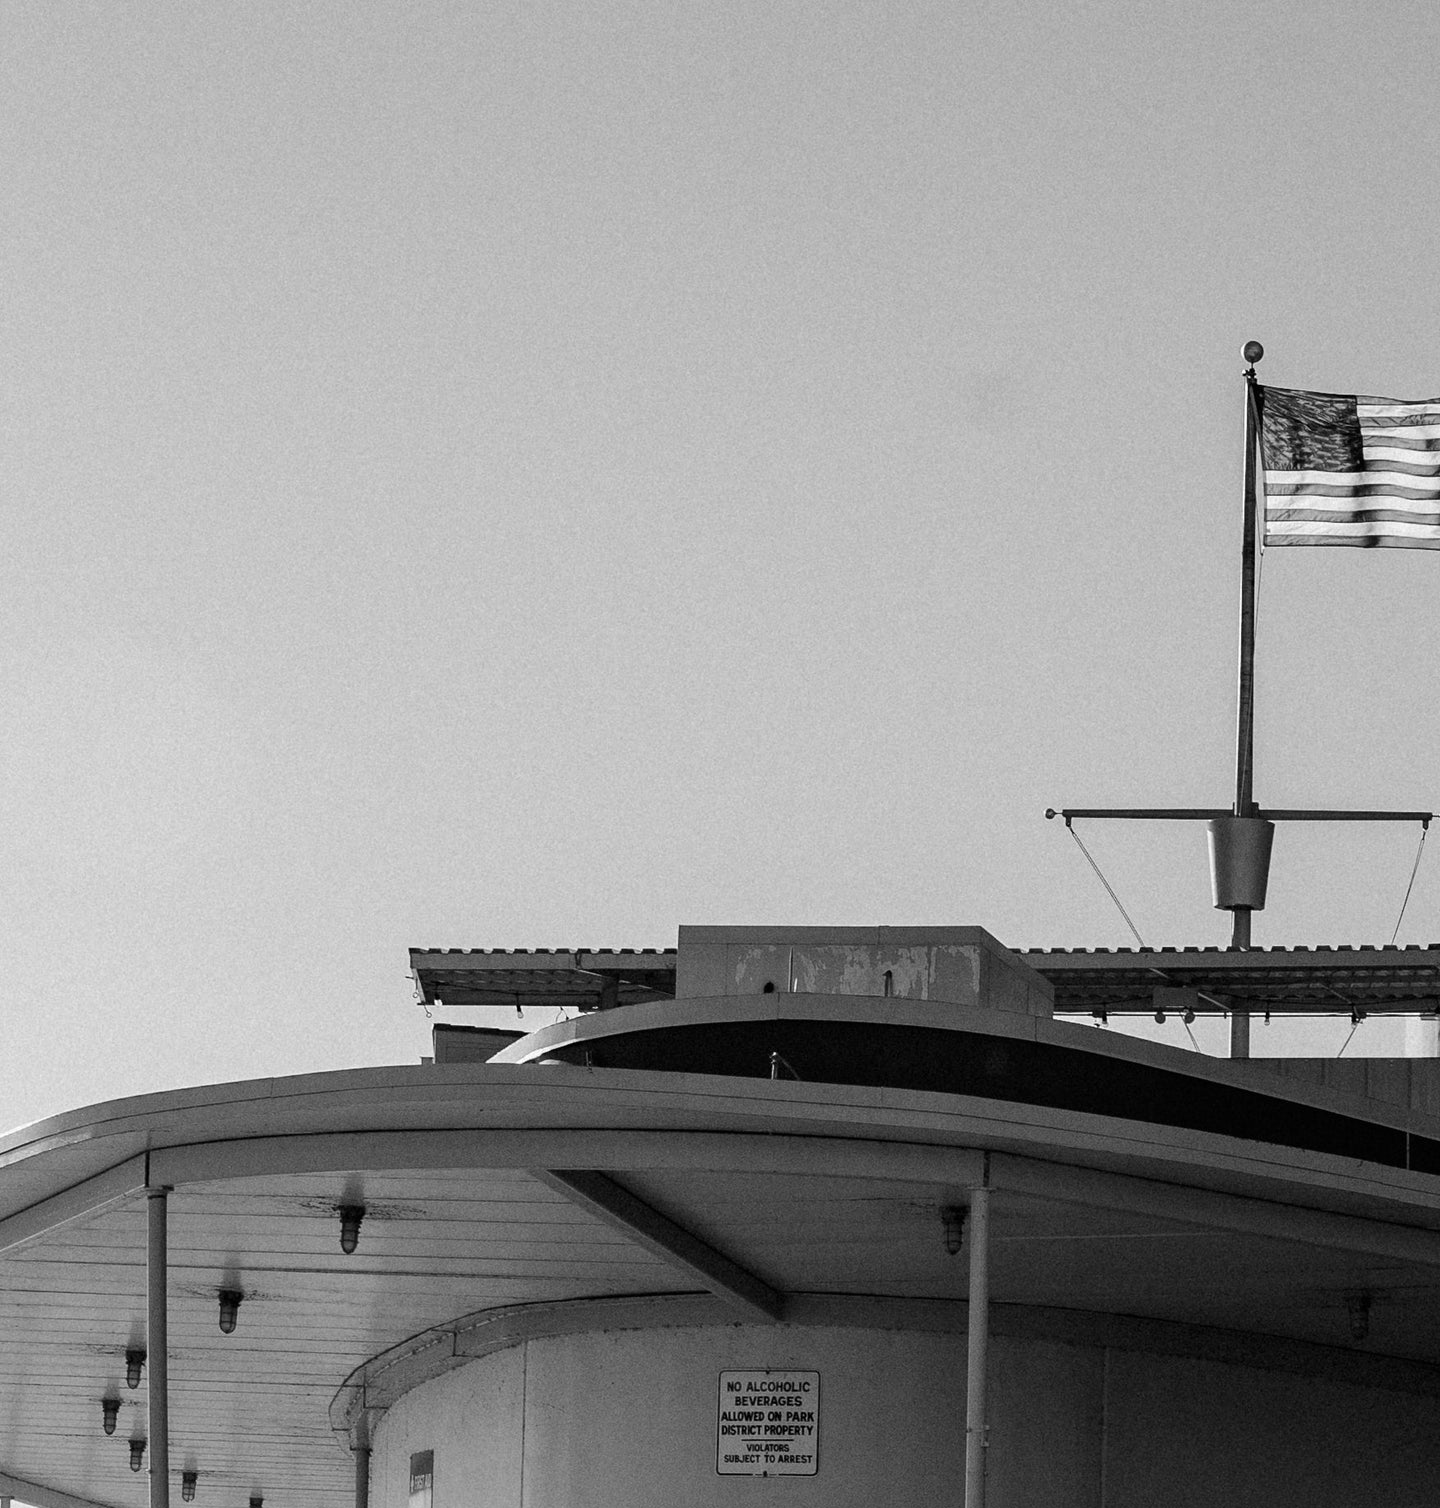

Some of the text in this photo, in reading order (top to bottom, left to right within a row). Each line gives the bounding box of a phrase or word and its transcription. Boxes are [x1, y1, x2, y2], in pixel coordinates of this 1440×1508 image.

[726, 1381, 811, 1393] NO ALCOHOLIC
[734, 1396, 803, 1407] BEVERAGES
[721, 1411, 815, 1422] ALLOWED ON PARK
[721, 1425, 814, 1436] DISTRICT PROPERTY
[746, 1444, 790, 1453] VIOLATORS
[723, 1454, 813, 1464] SUBJECT TO ARREST
